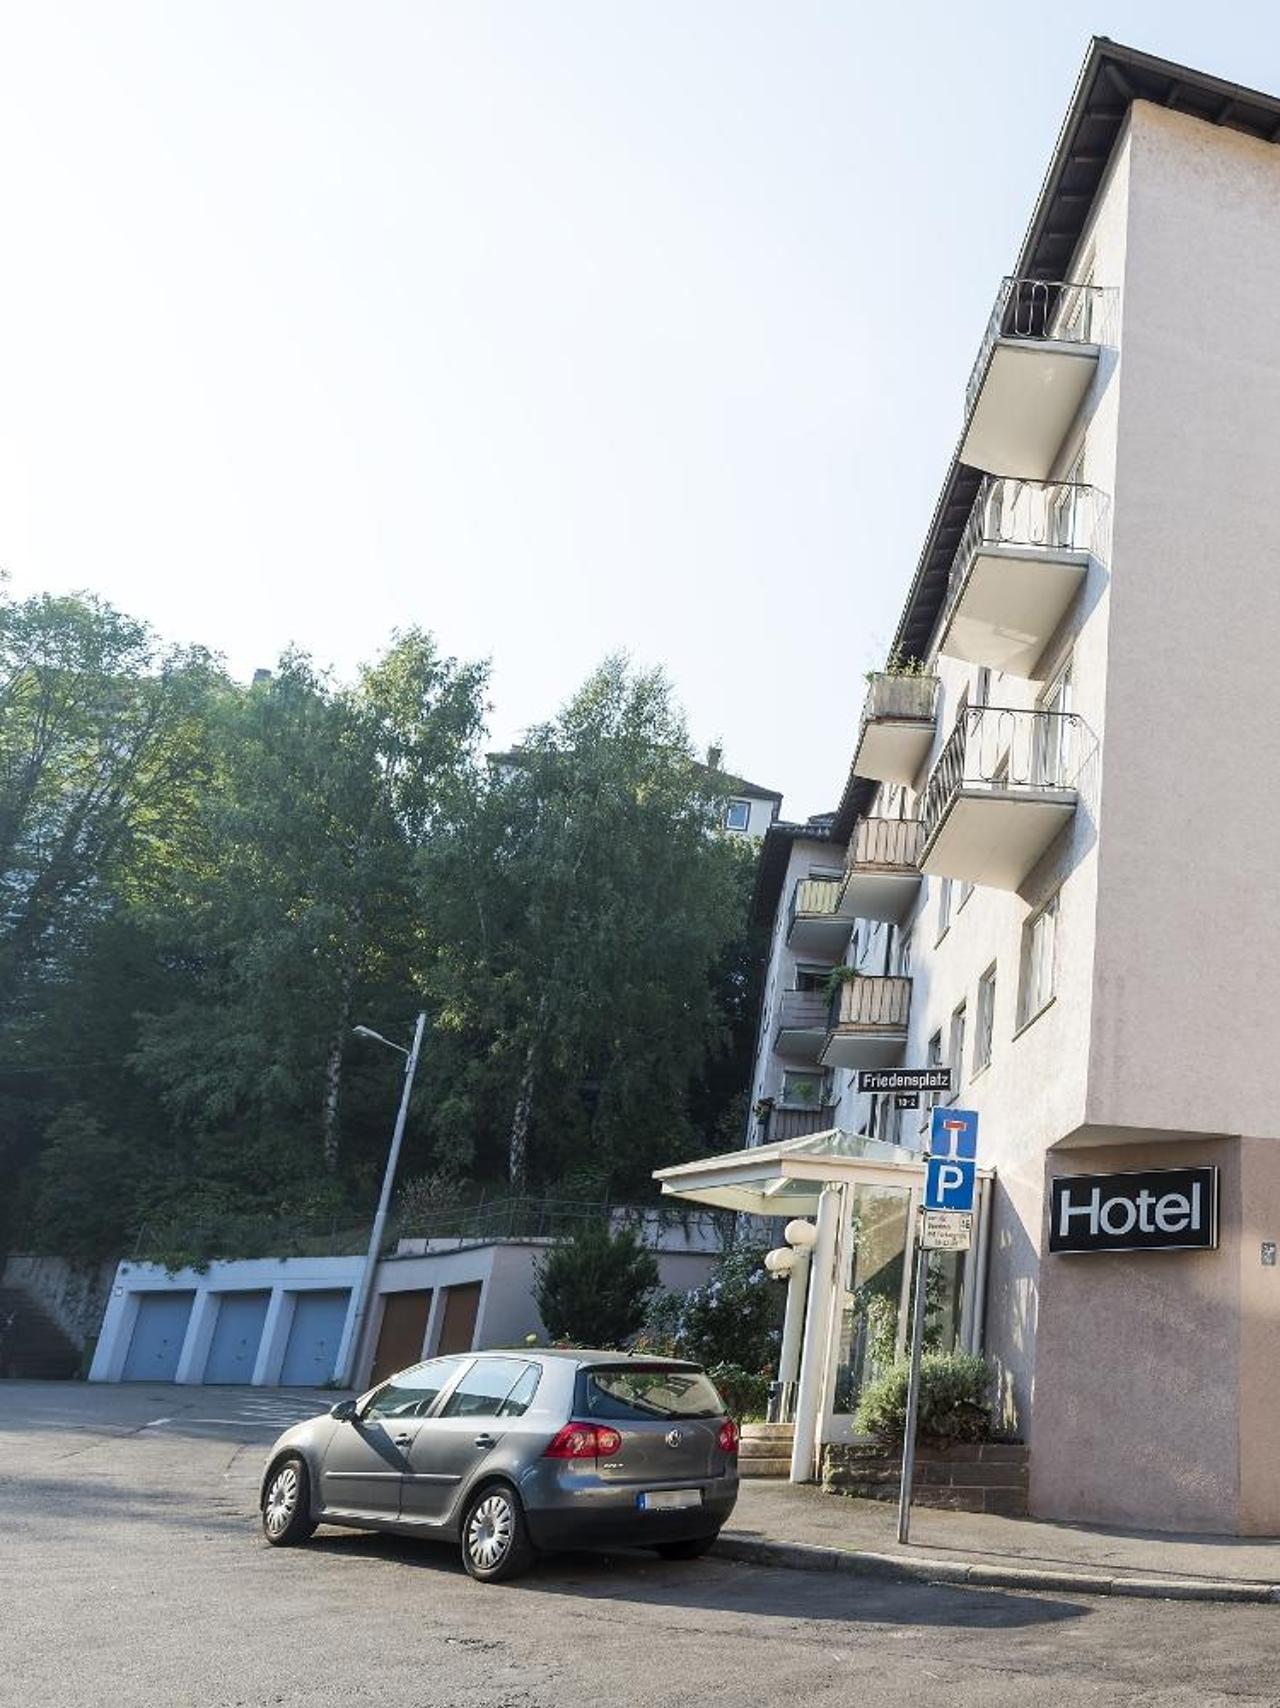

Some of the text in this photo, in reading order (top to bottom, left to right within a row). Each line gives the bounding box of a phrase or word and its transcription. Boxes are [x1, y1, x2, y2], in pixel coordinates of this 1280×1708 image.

[863, 1072, 949, 1089] Friedensplatz
[937, 1165, 964, 1203] P
[1059, 1182, 1201, 1236] Hotel
